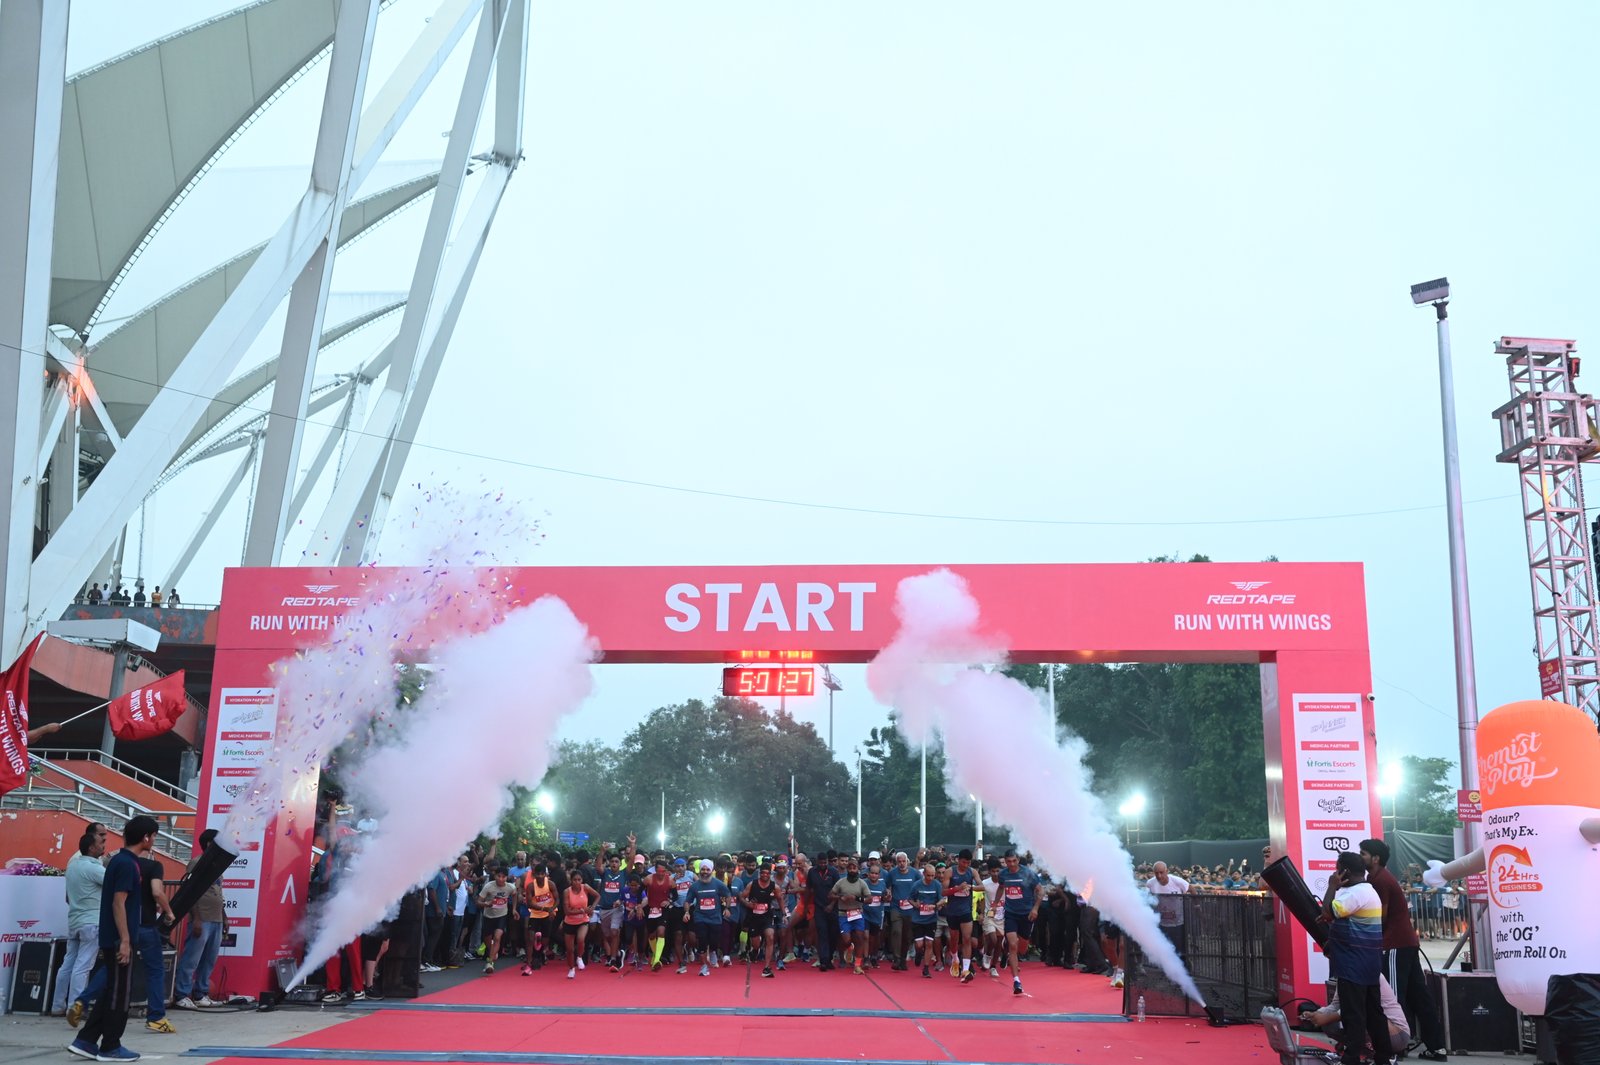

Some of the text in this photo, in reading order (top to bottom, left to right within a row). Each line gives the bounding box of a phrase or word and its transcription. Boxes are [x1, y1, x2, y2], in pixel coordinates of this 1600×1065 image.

[281, 597, 360, 606] REDTAPE
[1206, 594, 1296, 604] REDTAPE
[664, 582, 877, 632] START
[250, 615, 282, 630] RUN
[288, 615, 328, 630] WITH
[1174, 614, 1332, 630] RUN WITH WINGS
[2, 734, 25, 776] WINGS
[1479, 731, 1542, 772] hemist
[1487, 758, 1559, 795] Play
[1488, 812, 1519, 825] Odour?
[1502, 828, 1518, 840] My
[1519, 826, 1538, 837] Ex.
[1325, 838, 1348, 850] BRB
[1498, 865, 1540, 882] 24 Hrs
[1501, 884, 1538, 892] FRESHNESS
[1501, 912, 1524, 923] with
[1496, 930, 1508, 942] the
[1524, 946, 1546, 959] Roll
[1550, 947, 1567, 959] On
